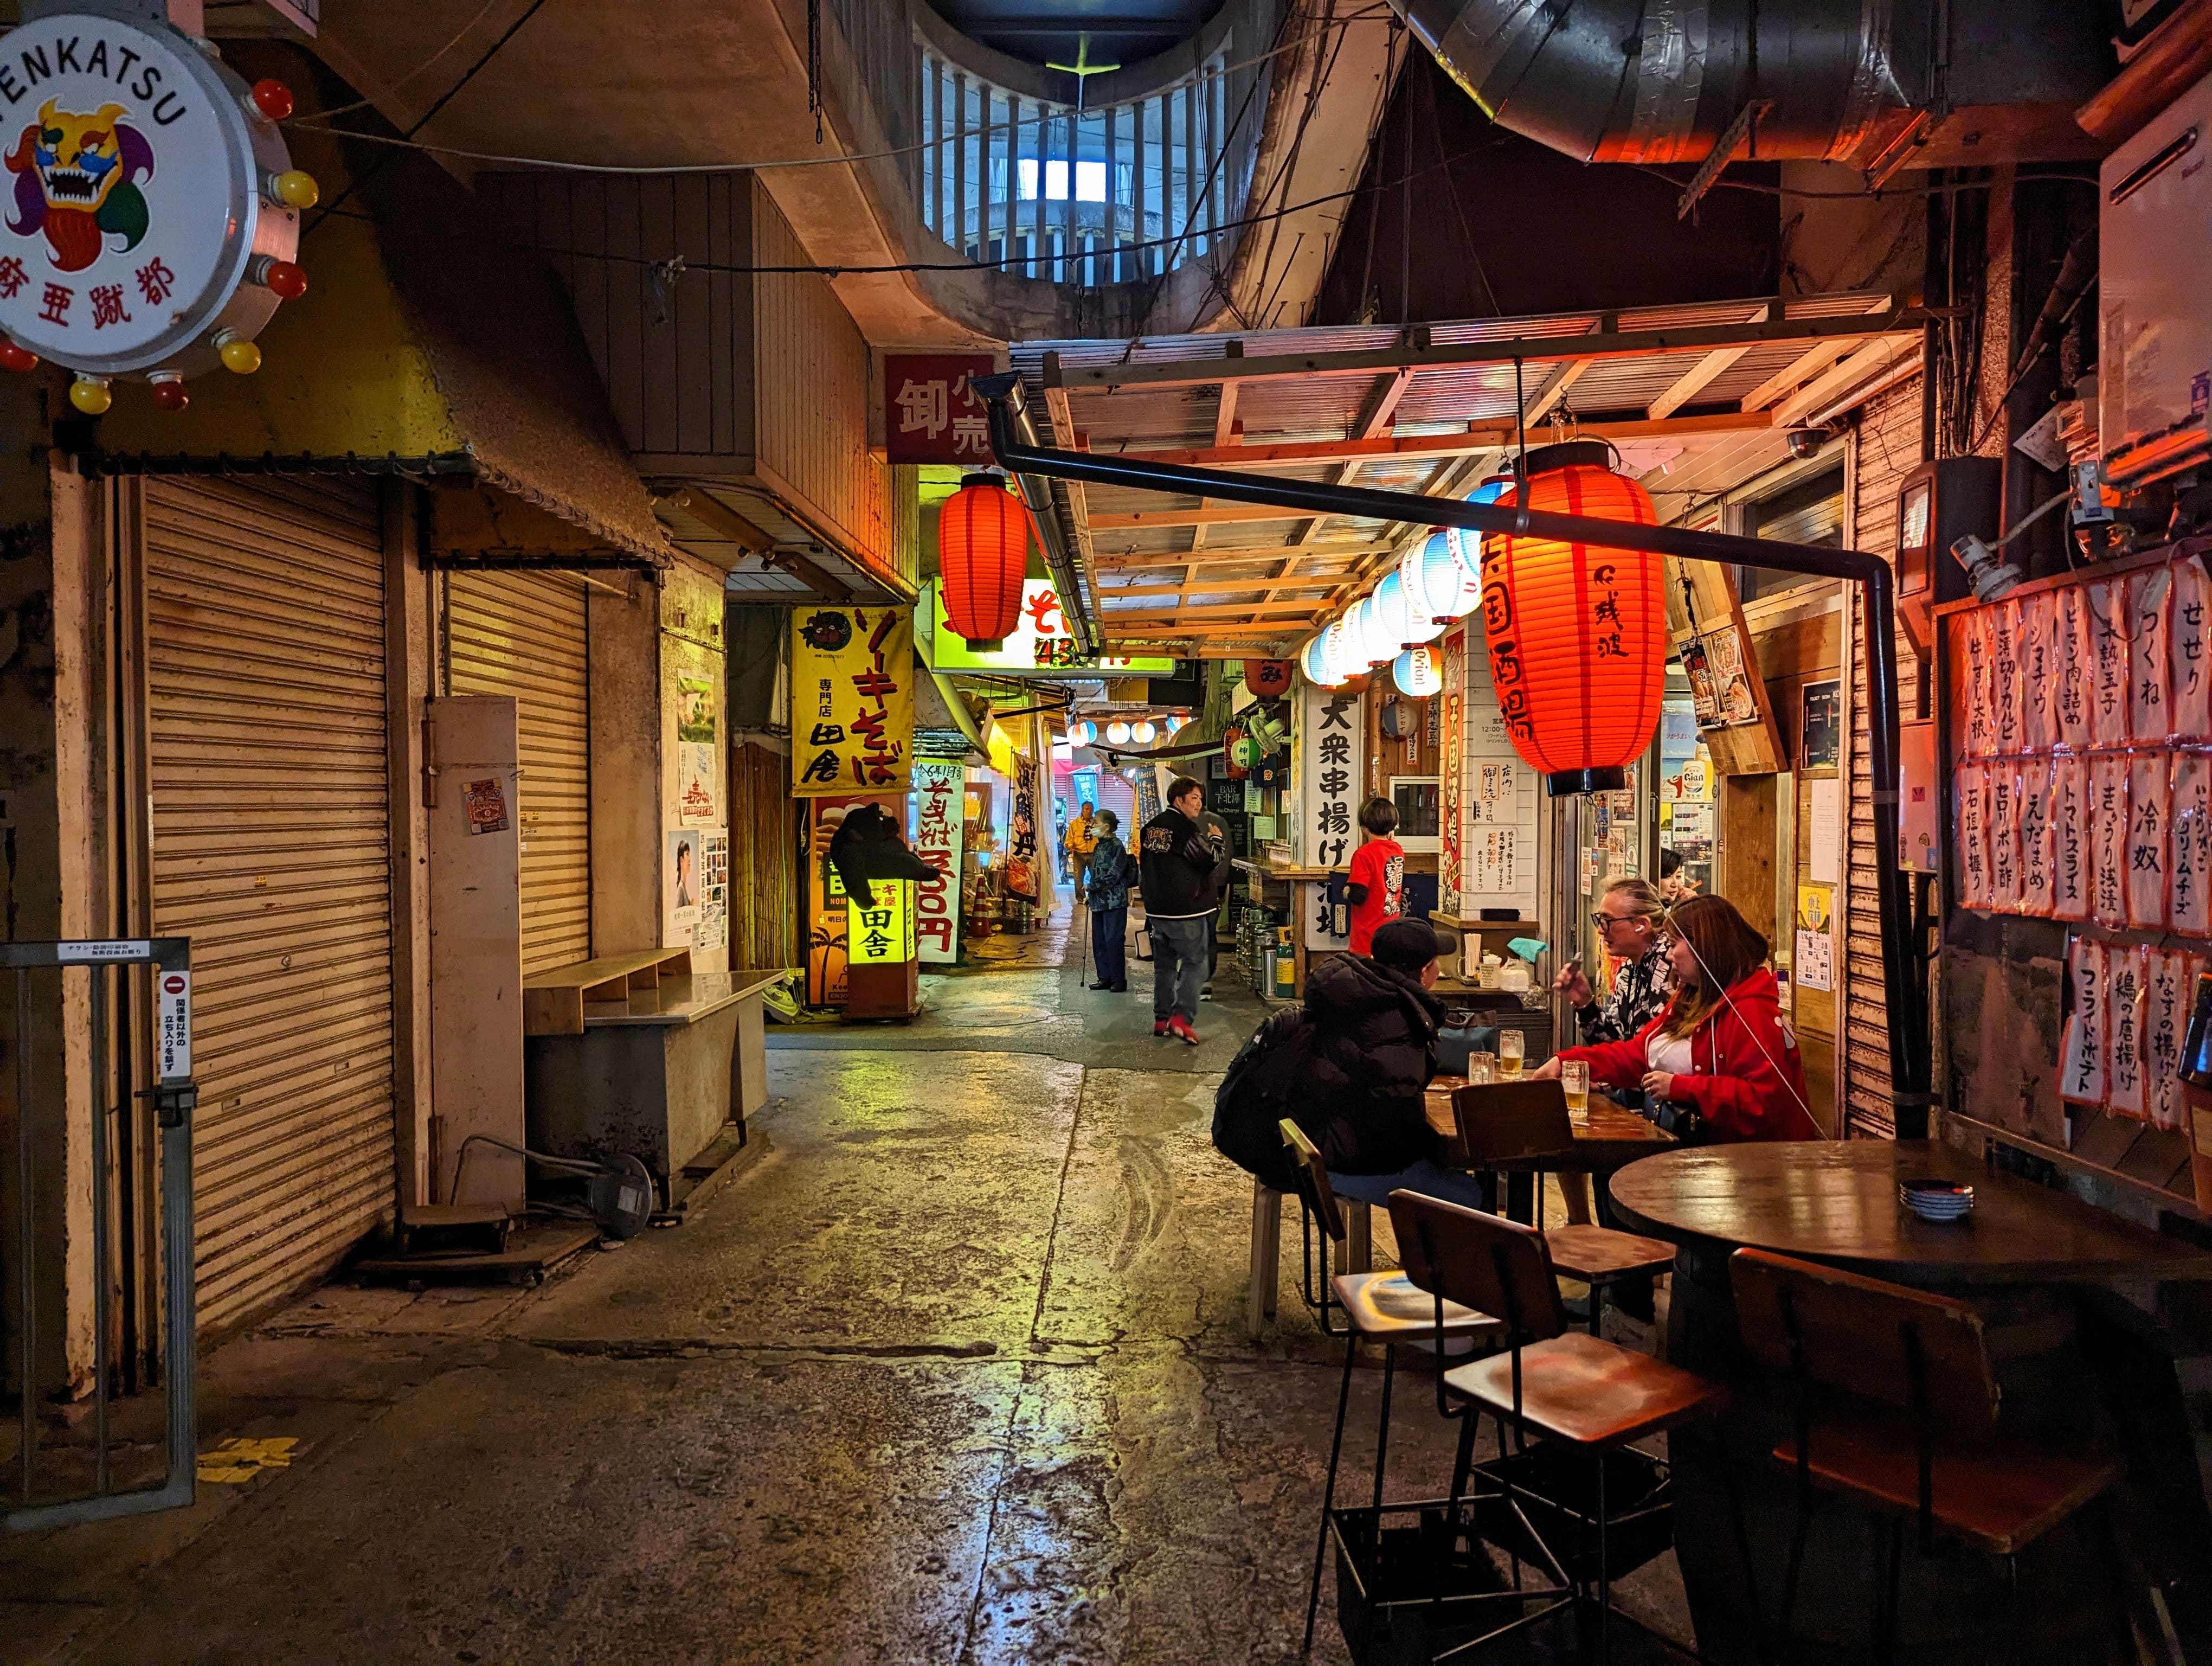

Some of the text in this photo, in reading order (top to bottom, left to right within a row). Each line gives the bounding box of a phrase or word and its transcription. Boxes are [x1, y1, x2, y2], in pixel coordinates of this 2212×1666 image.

[0, 36, 187, 126] ENKATSU
[895, 379, 948, 439] 卸
[1414, 650, 1427, 685] Orion
[1594, 591, 1629, 658] 残波
[2030, 625, 2047, 714] シマチョウ
[2063, 606, 2081, 725] ピーマン肉詰め
[2141, 611, 2160, 706] つくね
[2182, 601, 2204, 695] せせり
[818, 678, 833, 717] 専門店
[850, 607, 903, 786] ソーキそば
[1970, 637, 1988, 740] 牛すじ大根
[1998, 629, 2017, 741] 薄切りカルビ
[800, 723, 846, 784] 田舎
[1220, 785, 1236, 793] BAR
[1317, 694, 1353, 868] 大衆串揚げ
[1446, 693, 1459, 851] 天国酒場
[1966, 789, 1983, 890] 石垣牛握り
[2025, 794, 2046, 890] えだまめ
[2066, 784, 2079, 900] トマトスライス
[2132, 798, 2162, 874] 冷奴
[857, 909, 897, 958] 田舎
[870, 883, 897, 896] ーキ
[164, 1015, 175, 1072] 立ち入りを禁ず
[176, 998, 186, 1047] 関係者以外の
[2115, 969, 2137, 1092] 鶏の唐揚げ
